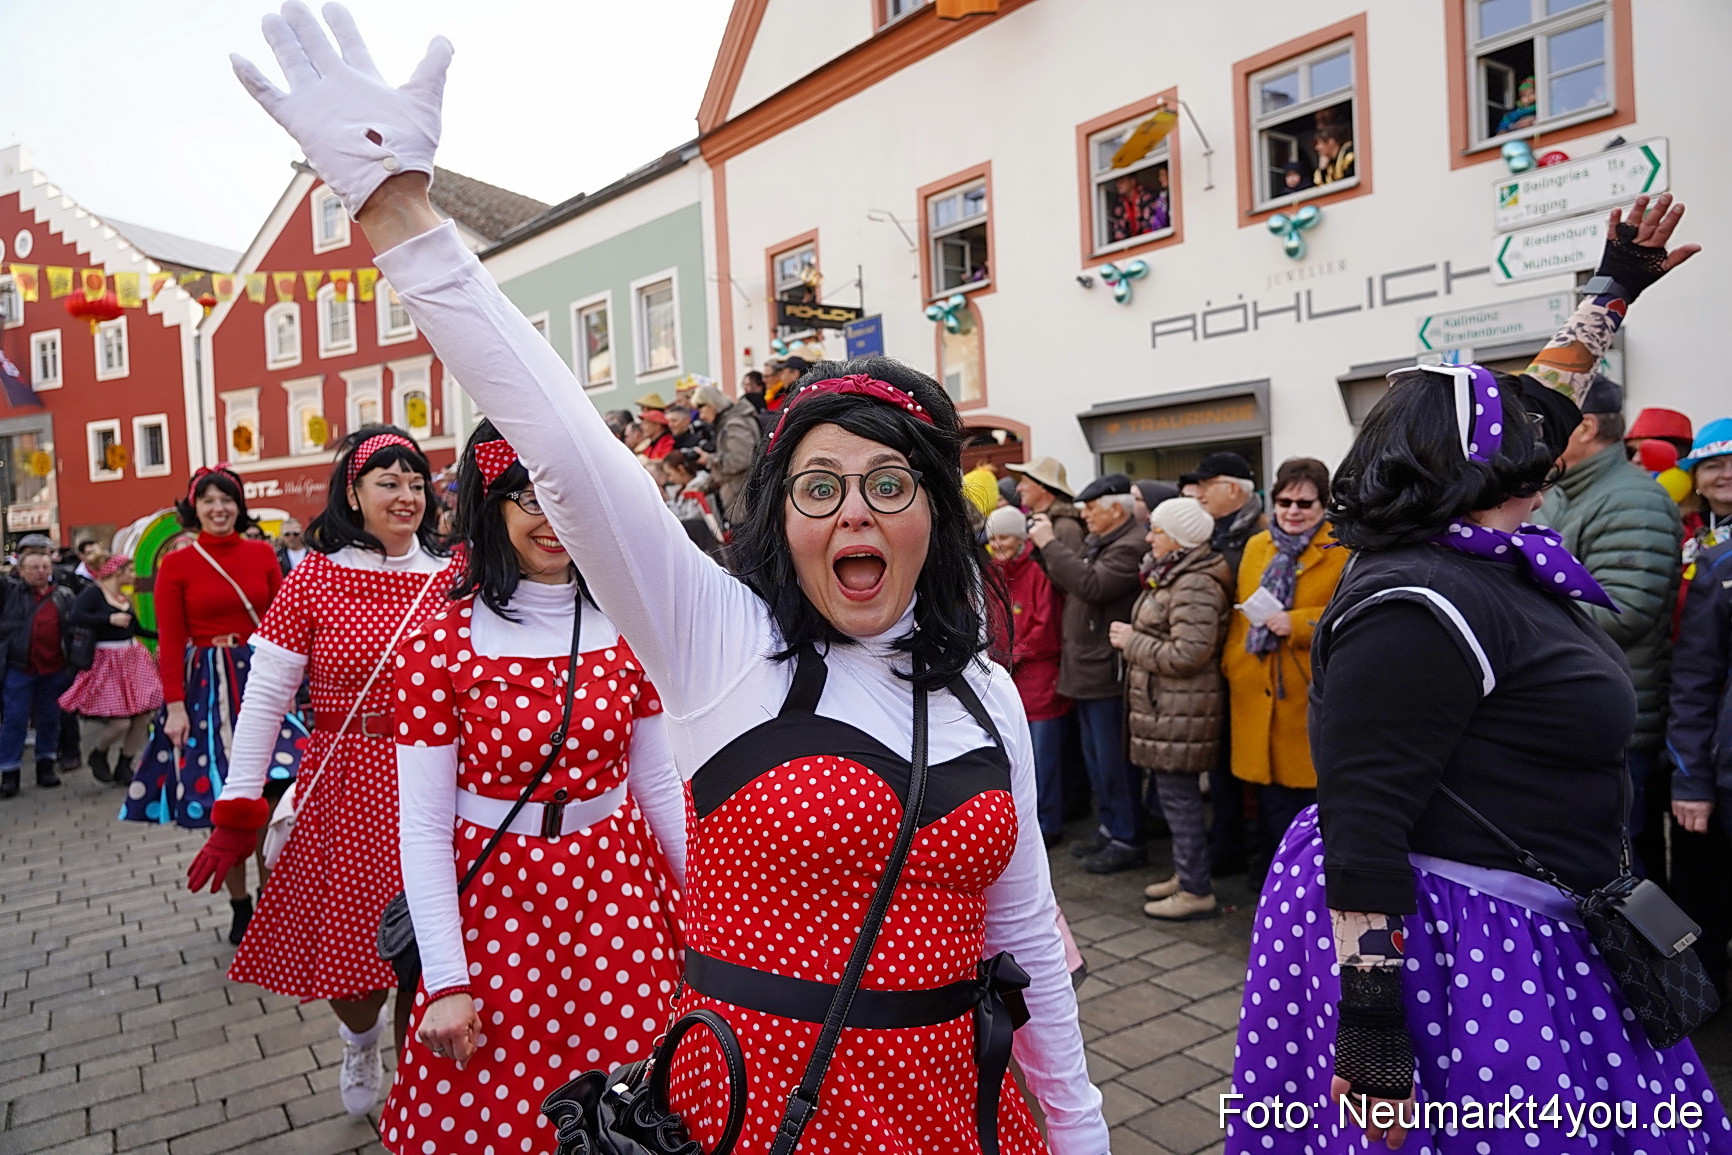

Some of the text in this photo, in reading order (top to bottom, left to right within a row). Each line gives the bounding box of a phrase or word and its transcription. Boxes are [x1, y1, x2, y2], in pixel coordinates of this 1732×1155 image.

[1523, 224, 1598, 247] Riedenburg
[1151, 261, 1491, 349] RÖHLICH
[1128, 404, 1255, 432] TRAURINGE
